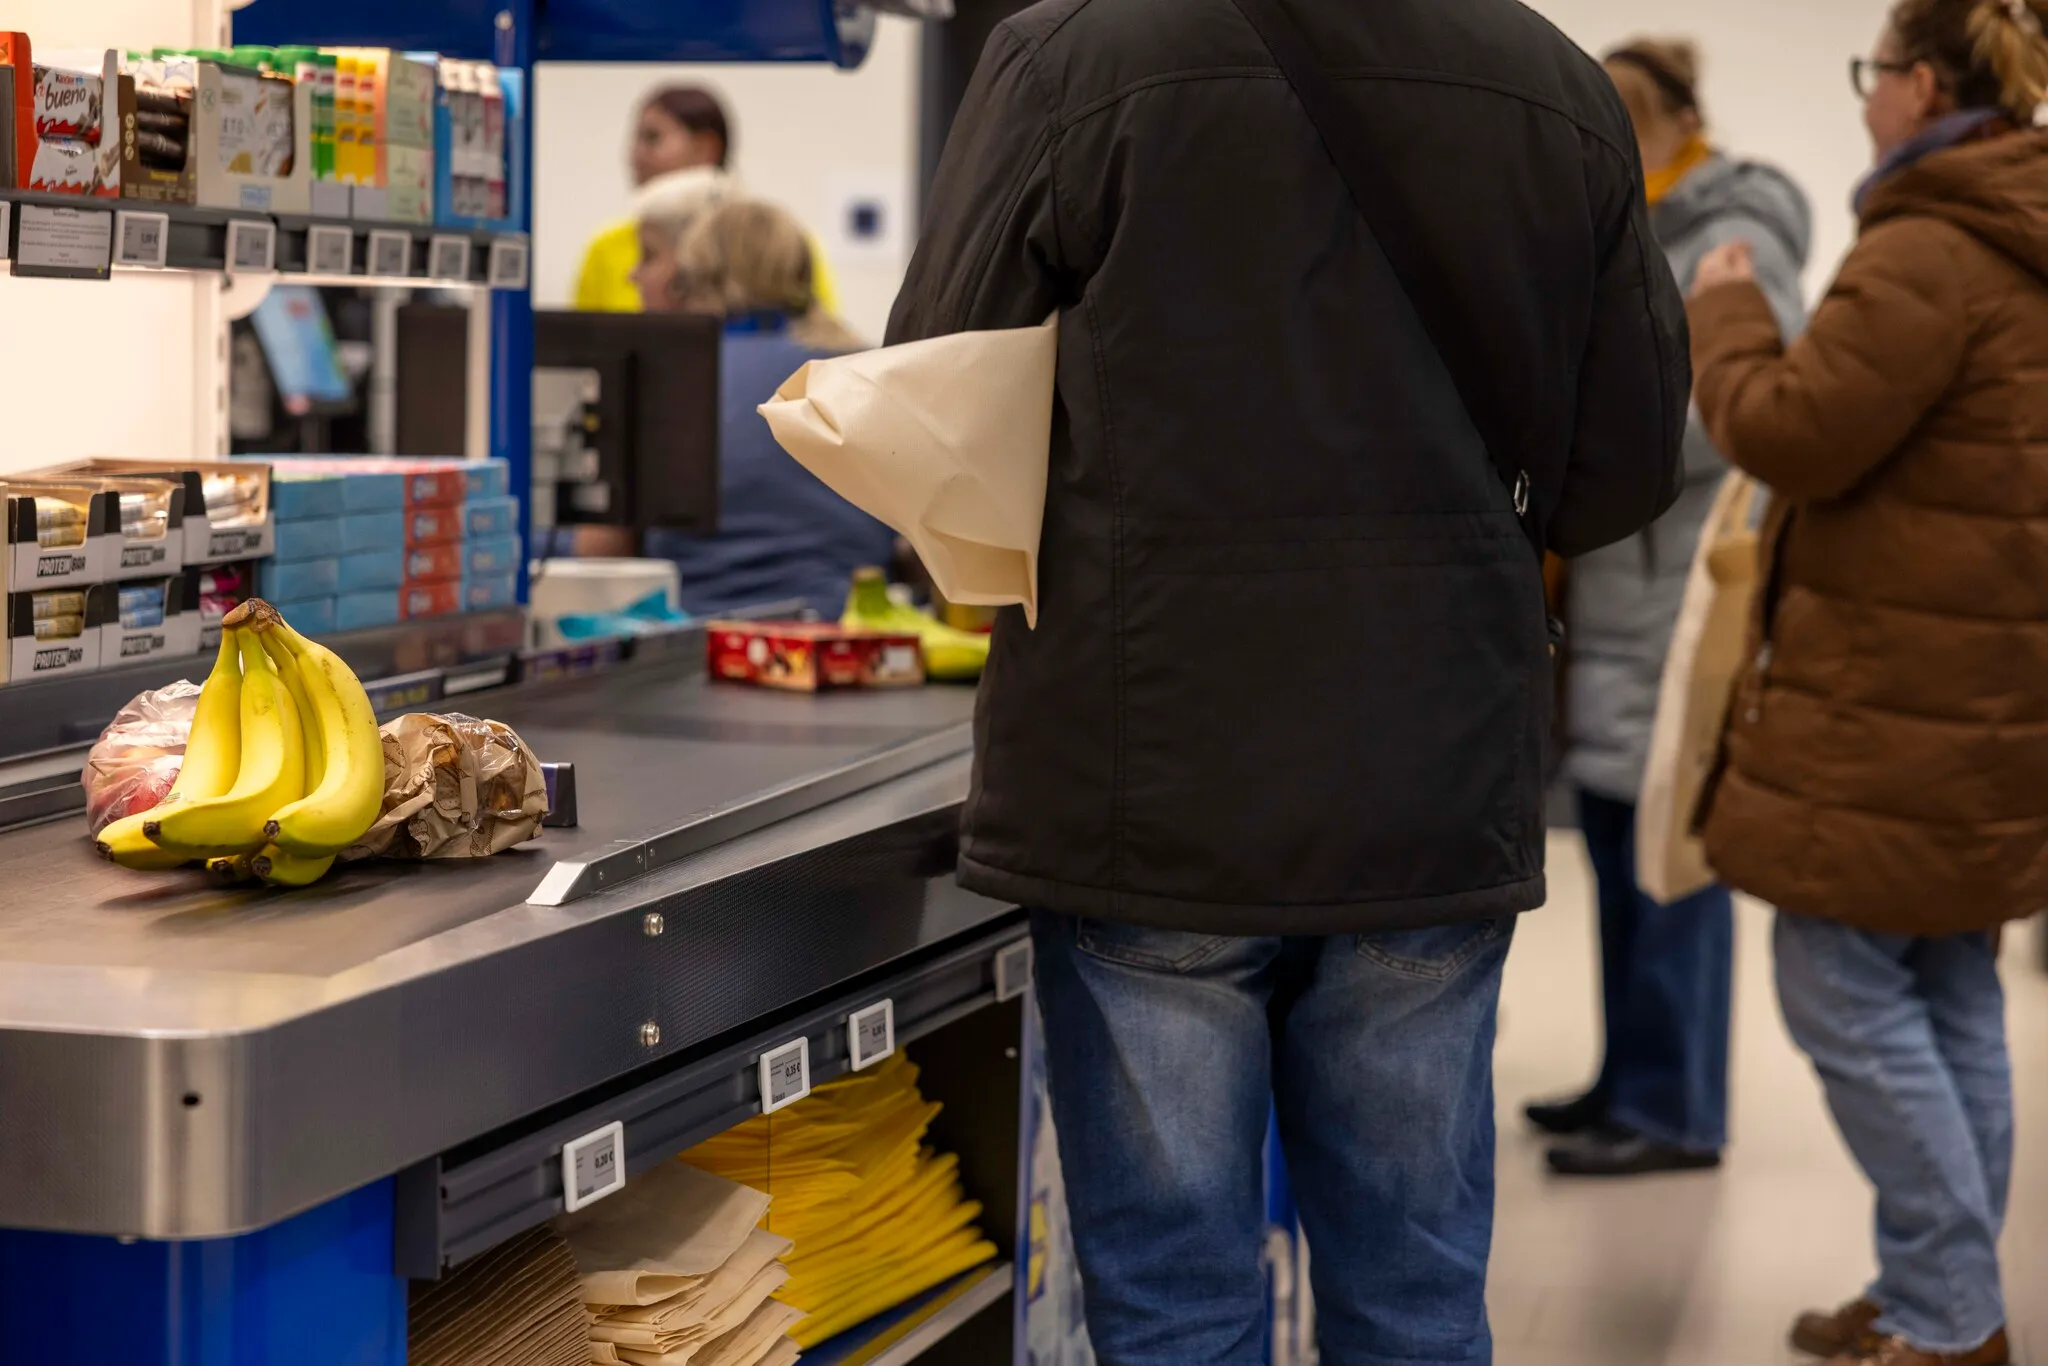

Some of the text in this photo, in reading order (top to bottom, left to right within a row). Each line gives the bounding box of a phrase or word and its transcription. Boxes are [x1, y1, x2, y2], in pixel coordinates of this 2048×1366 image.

[45, 82, 86, 111] bueno
[37, 554, 72, 577] PROTEIN
[34, 648, 69, 671] PROTEIN
